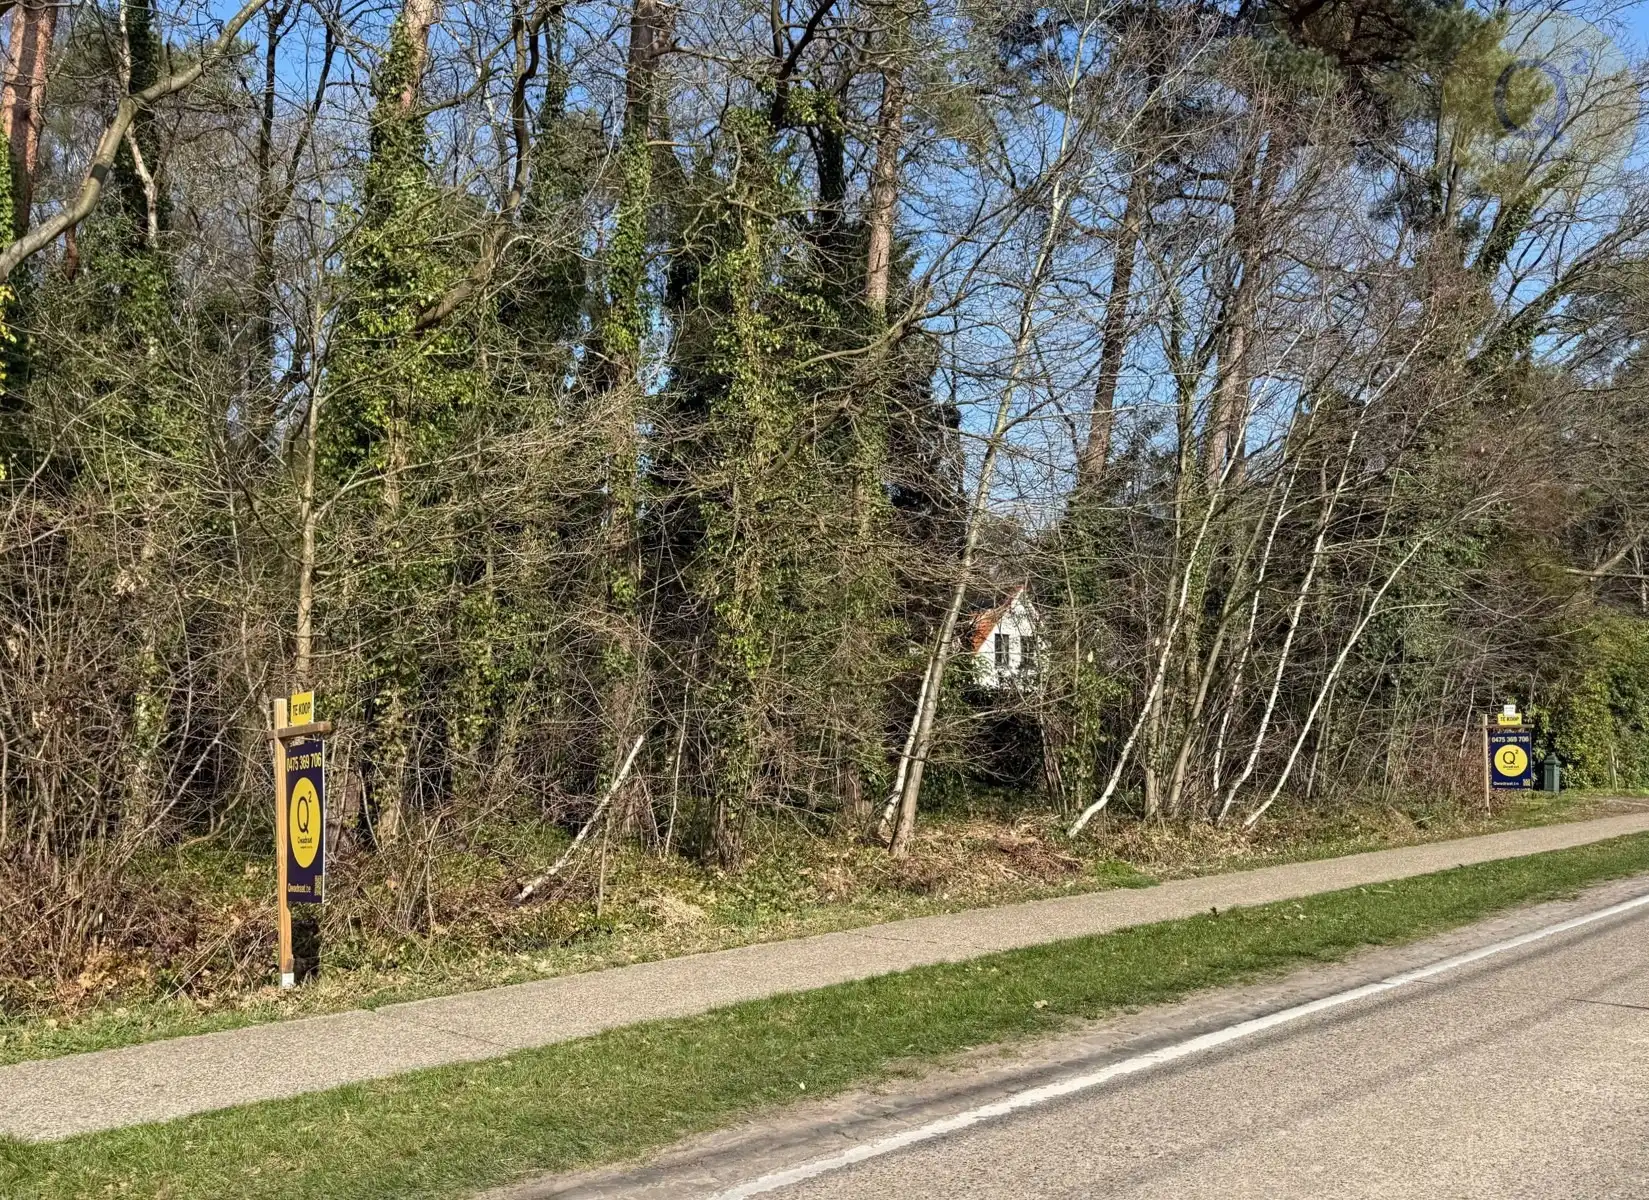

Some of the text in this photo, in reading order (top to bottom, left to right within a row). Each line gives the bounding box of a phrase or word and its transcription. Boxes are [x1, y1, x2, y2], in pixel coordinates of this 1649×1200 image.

[293, 702, 311, 716] TE KOOP
[286, 757, 299, 772] 0475
[310, 752, 322, 768] 706
